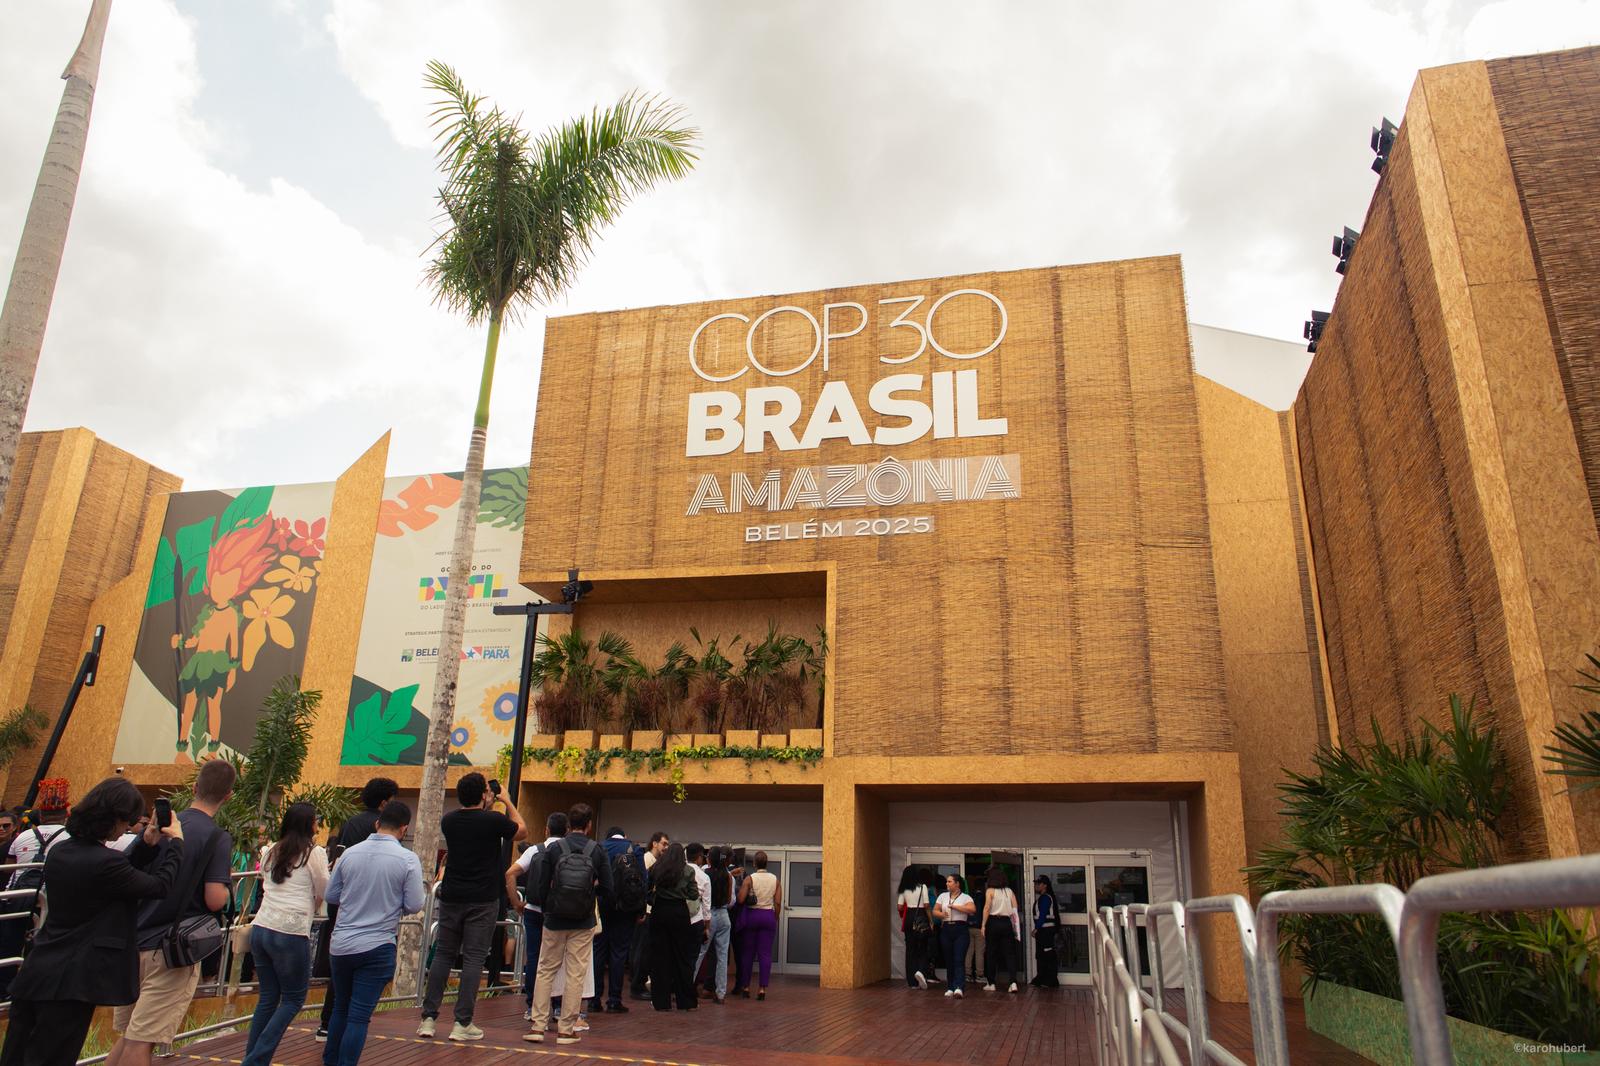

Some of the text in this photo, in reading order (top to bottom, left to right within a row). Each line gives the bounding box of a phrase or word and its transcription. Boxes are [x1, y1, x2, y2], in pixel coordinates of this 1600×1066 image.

[688, 288, 1008, 382] COP 30
[685, 369, 1009, 457] BRASIL
[686, 455, 1019, 516] AMAZÔNIA
[745, 517, 930, 542] BELÉM 2025
